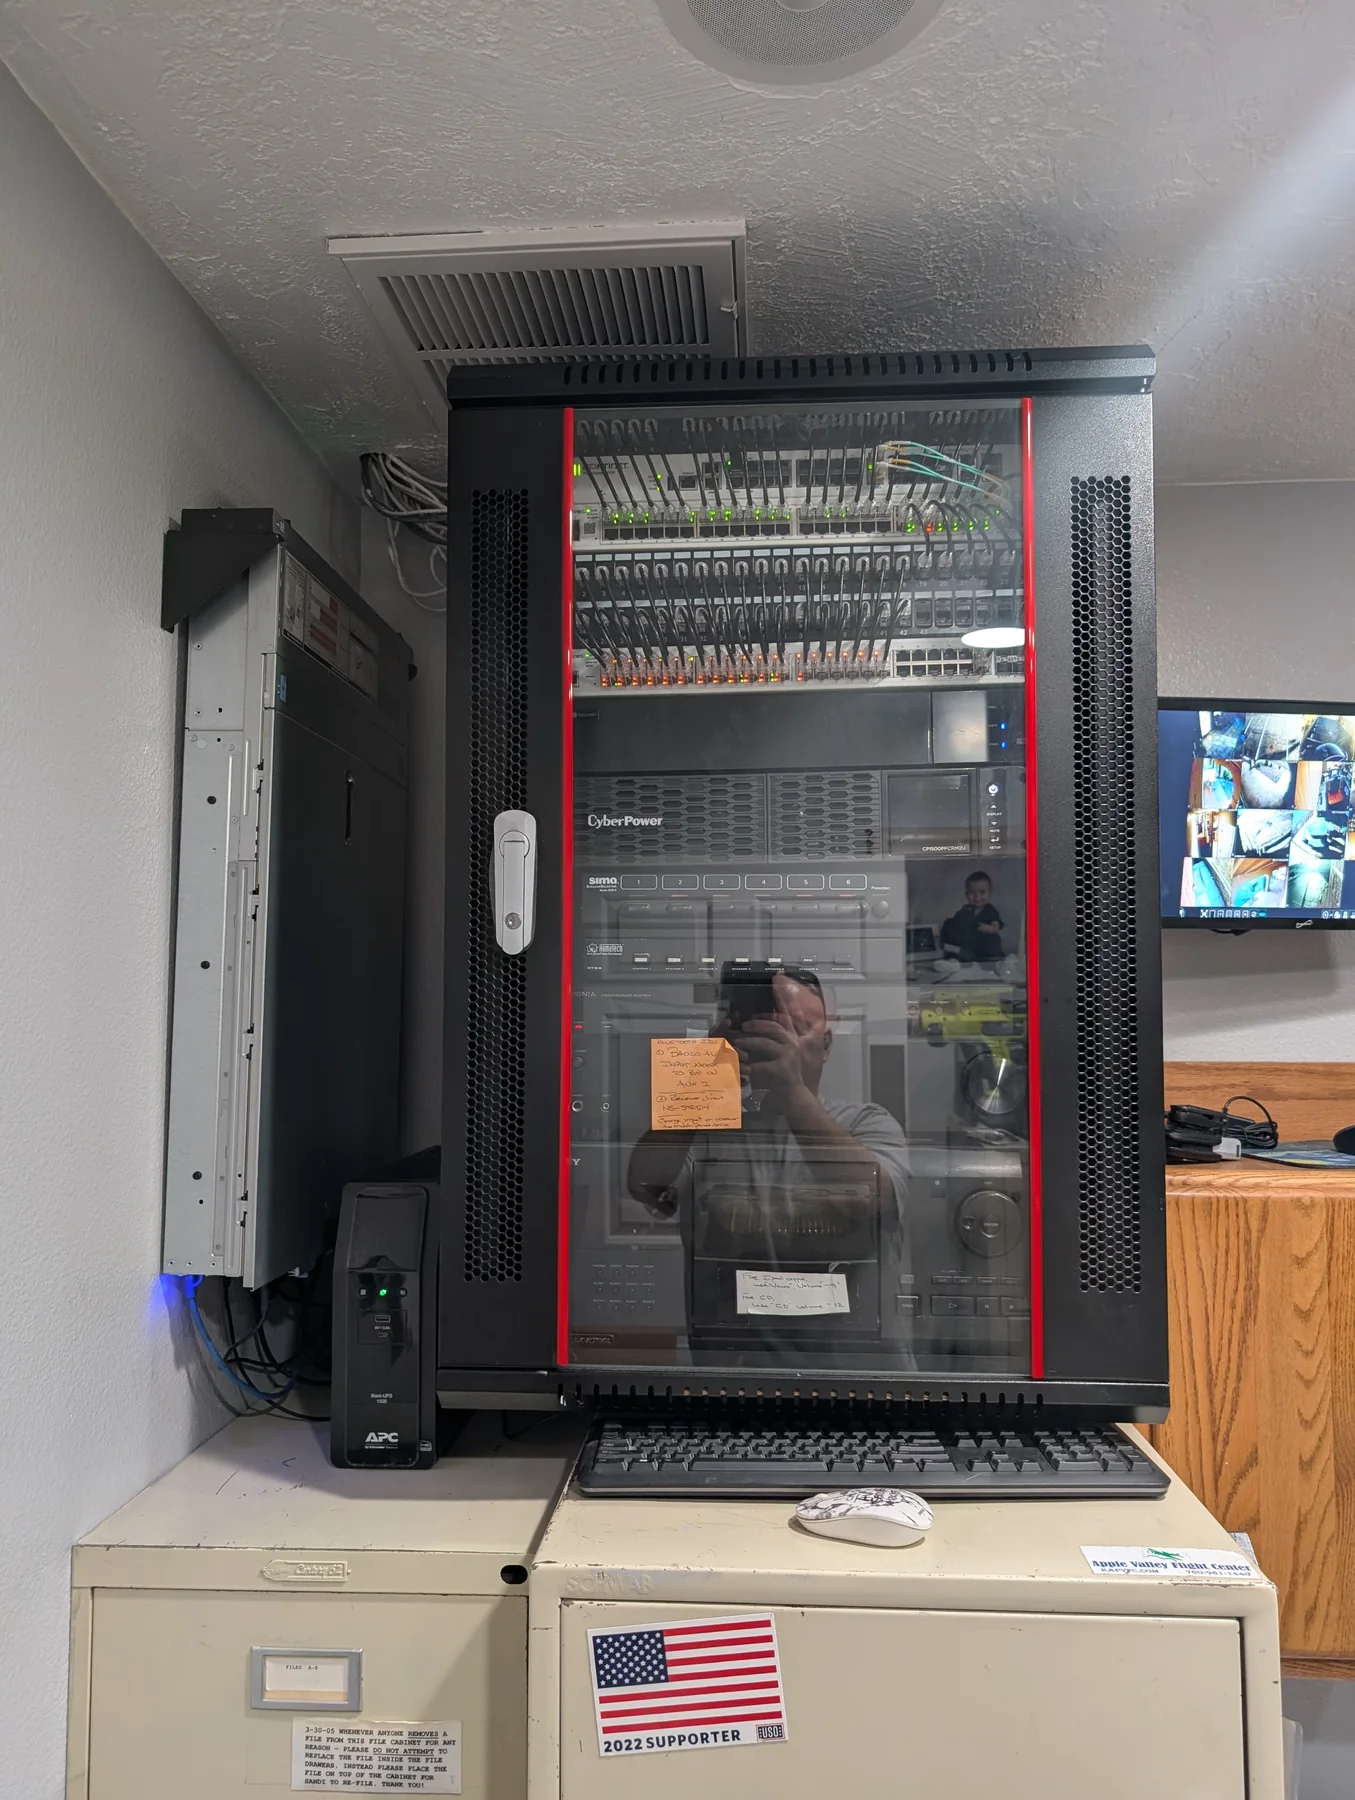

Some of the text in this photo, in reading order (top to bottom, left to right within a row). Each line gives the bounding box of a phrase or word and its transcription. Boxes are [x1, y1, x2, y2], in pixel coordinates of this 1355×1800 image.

[587, 814, 663, 829] CyberPower
[365, 1432, 398, 1442] APC
[1092, 1560, 1251, 1571] Apple Valley Flight Center
[762, 1726, 778, 1738] USO
[604, 1729, 741, 1753] 2022 SUPPORTER
